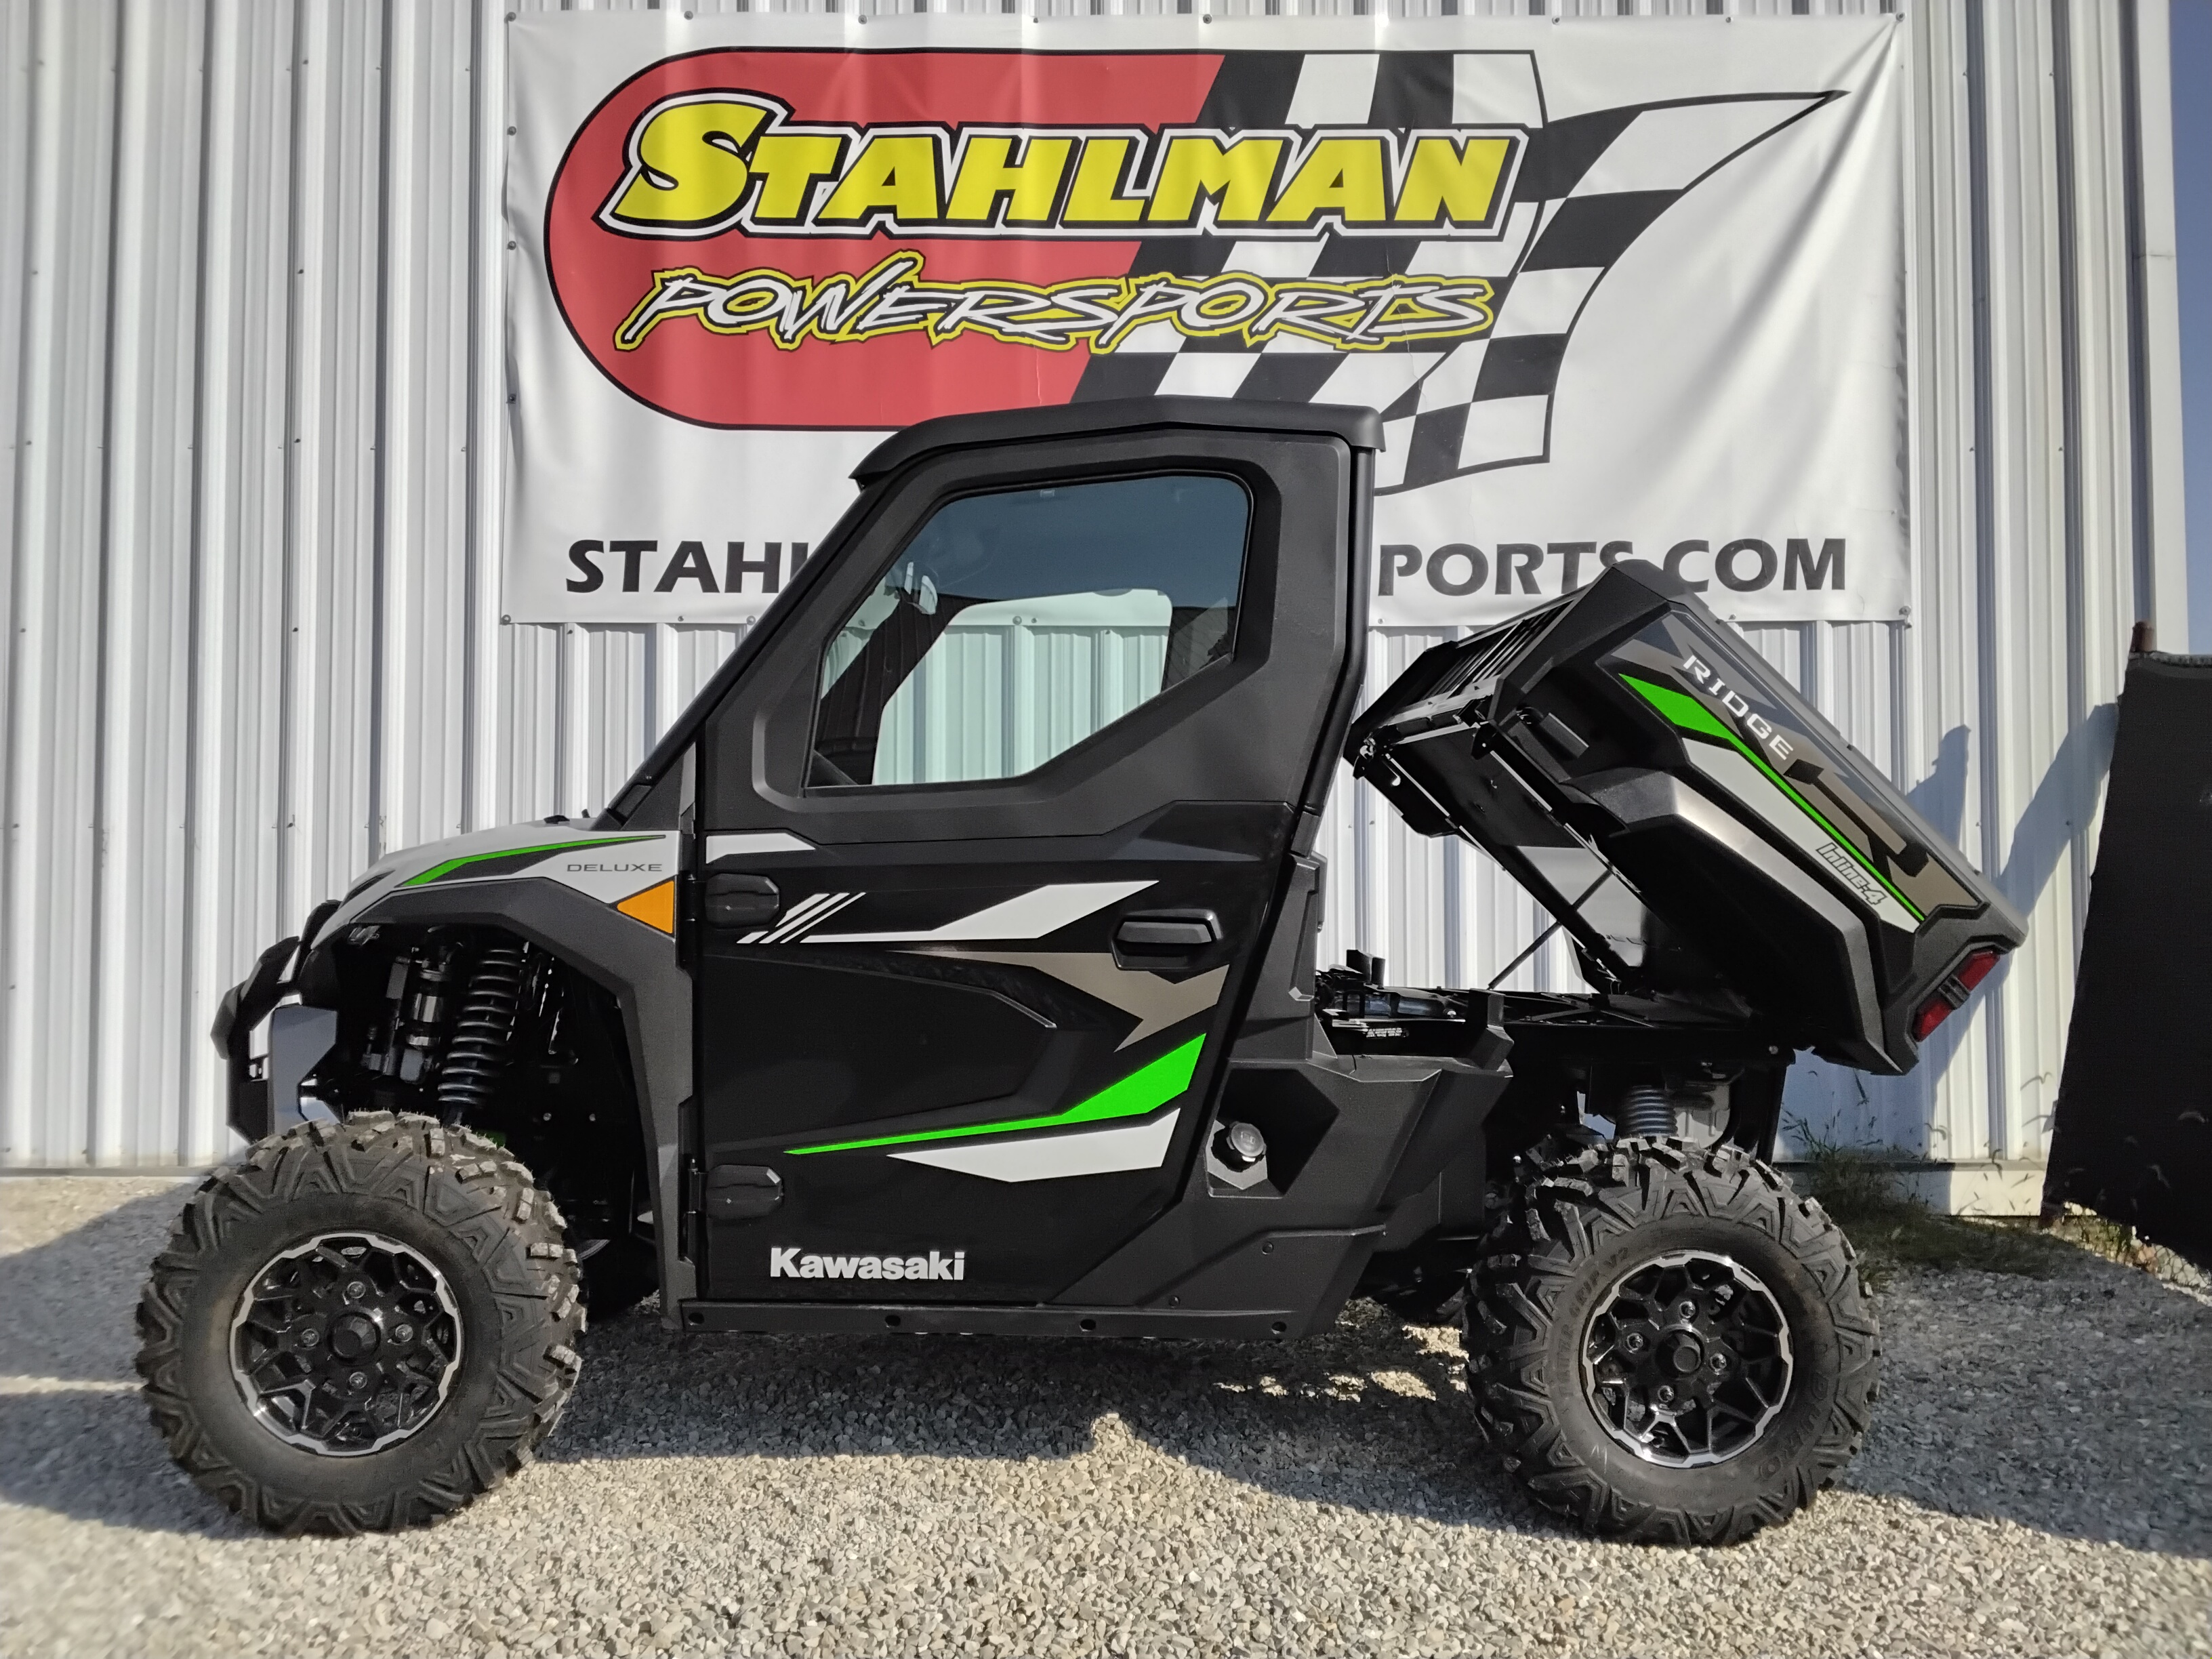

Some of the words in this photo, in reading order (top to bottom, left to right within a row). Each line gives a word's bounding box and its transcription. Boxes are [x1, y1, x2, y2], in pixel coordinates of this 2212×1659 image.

[594, 89, 1529, 241] STAHLMAN
[615, 250, 1494, 354] POWERSPORTS
[1683, 655, 1794, 760] RIDGE
[1816, 842, 1887, 905] Inline-4
[770, 1247, 965, 1280] Kawasaki
